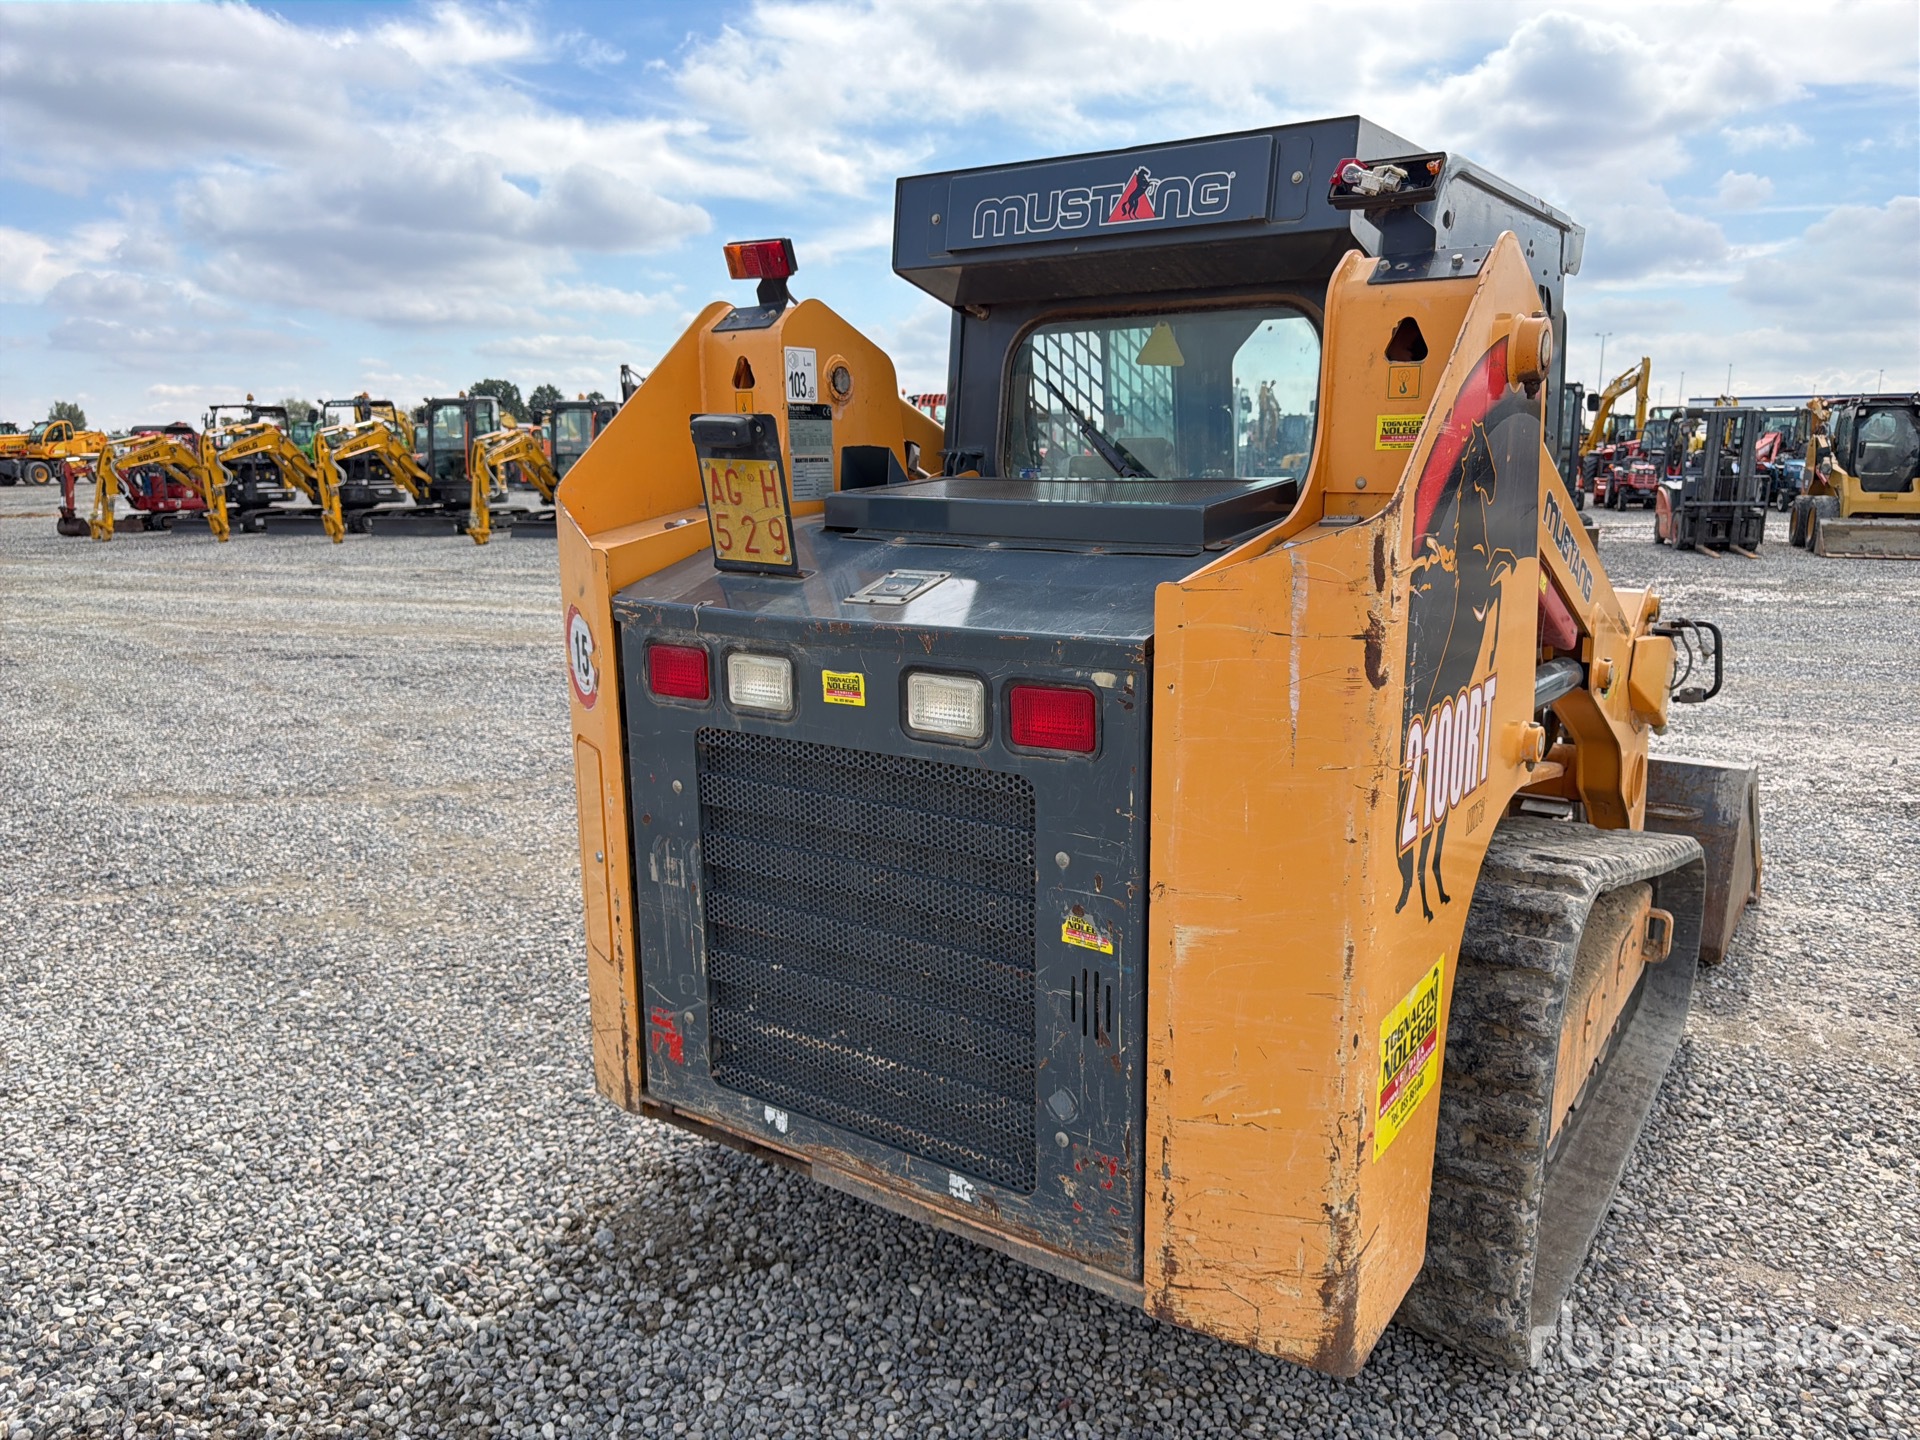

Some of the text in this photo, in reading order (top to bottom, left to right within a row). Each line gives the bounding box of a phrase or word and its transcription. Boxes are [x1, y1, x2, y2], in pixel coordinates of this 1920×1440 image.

[972, 167, 1233, 239] MUSTANG
[788, 371, 807, 398] 103
[711, 467, 742, 506] AG
[759, 469, 780, 509] H
[716, 513, 786, 555] 529
[1542, 489, 1594, 604] MUSTANG
[574, 630, 590, 678] 15
[1400, 672, 1497, 850] 2100RT
[1383, 1005, 1438, 1088] NOLEGGI
